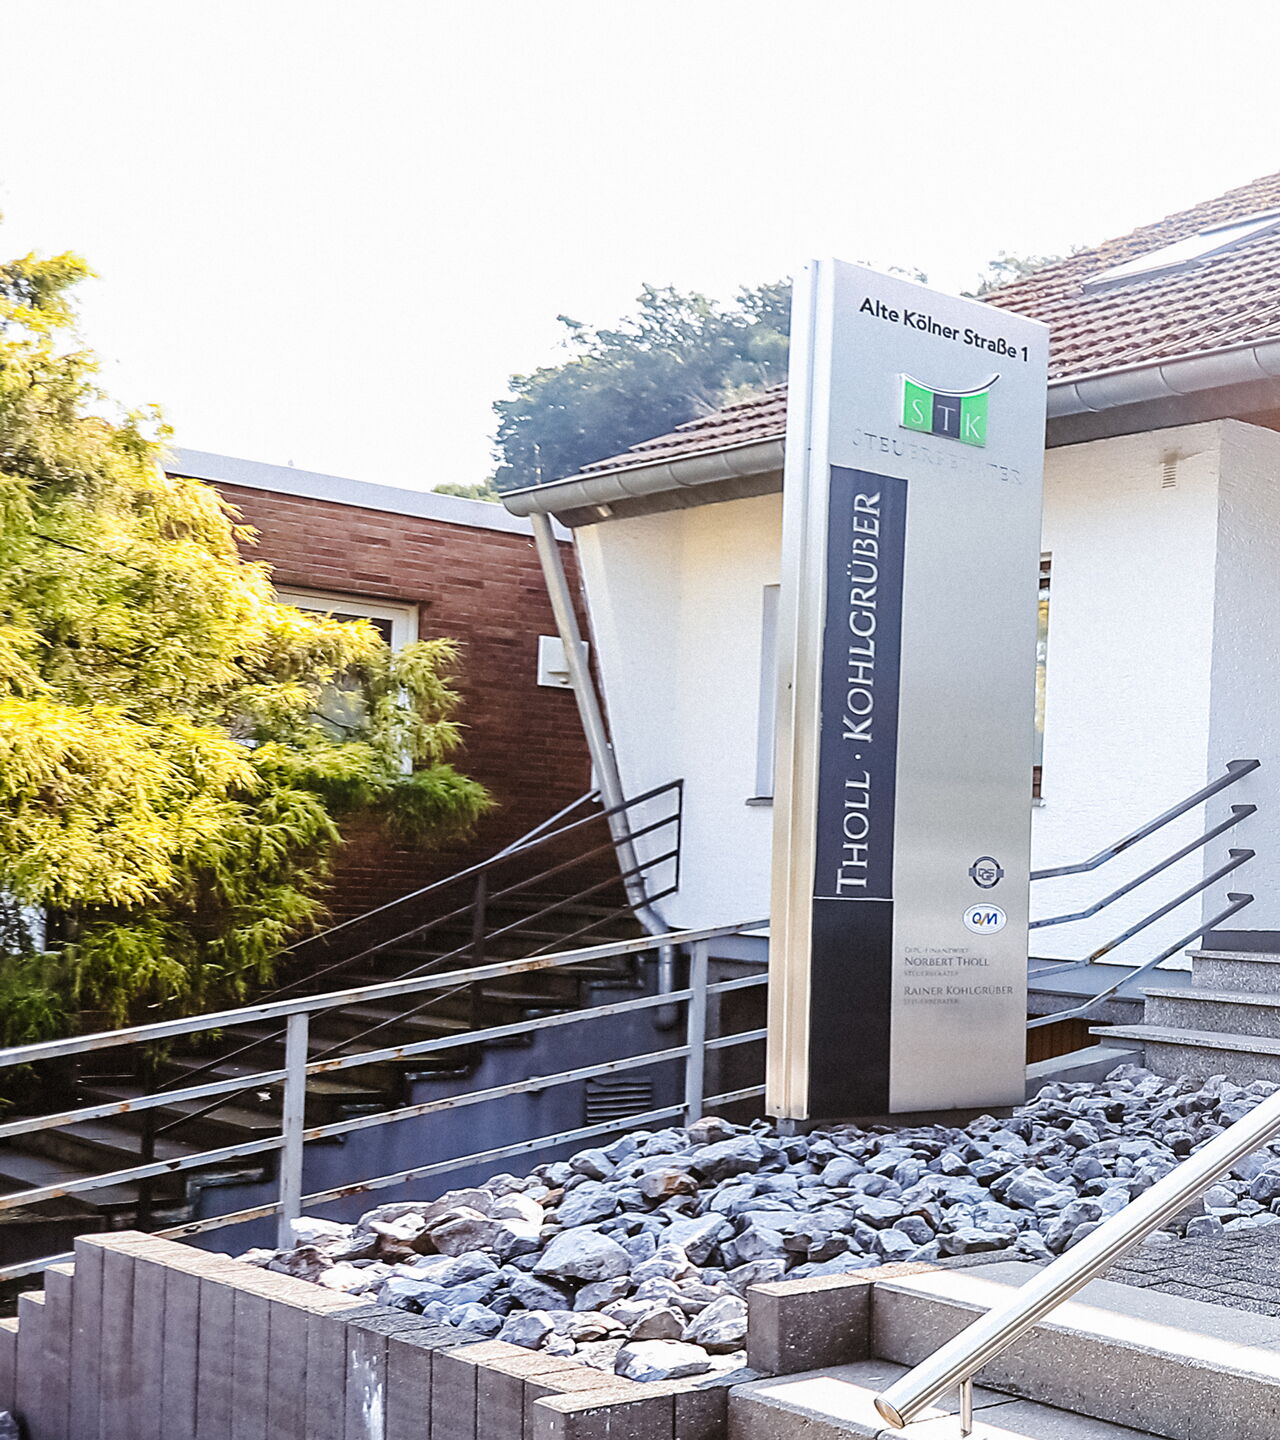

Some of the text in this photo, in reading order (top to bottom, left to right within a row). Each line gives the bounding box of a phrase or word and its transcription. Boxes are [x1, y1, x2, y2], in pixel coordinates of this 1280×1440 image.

[859, 297, 1028, 362] Alte Kölner Straße 1
[911, 399, 981, 440] STK
[843, 492, 881, 743] KOHLGRÜBER
[836, 770, 870, 894] THOLL
[905, 956, 990, 967] NORBERT THOLL
[904, 986, 943, 996] RAINER
